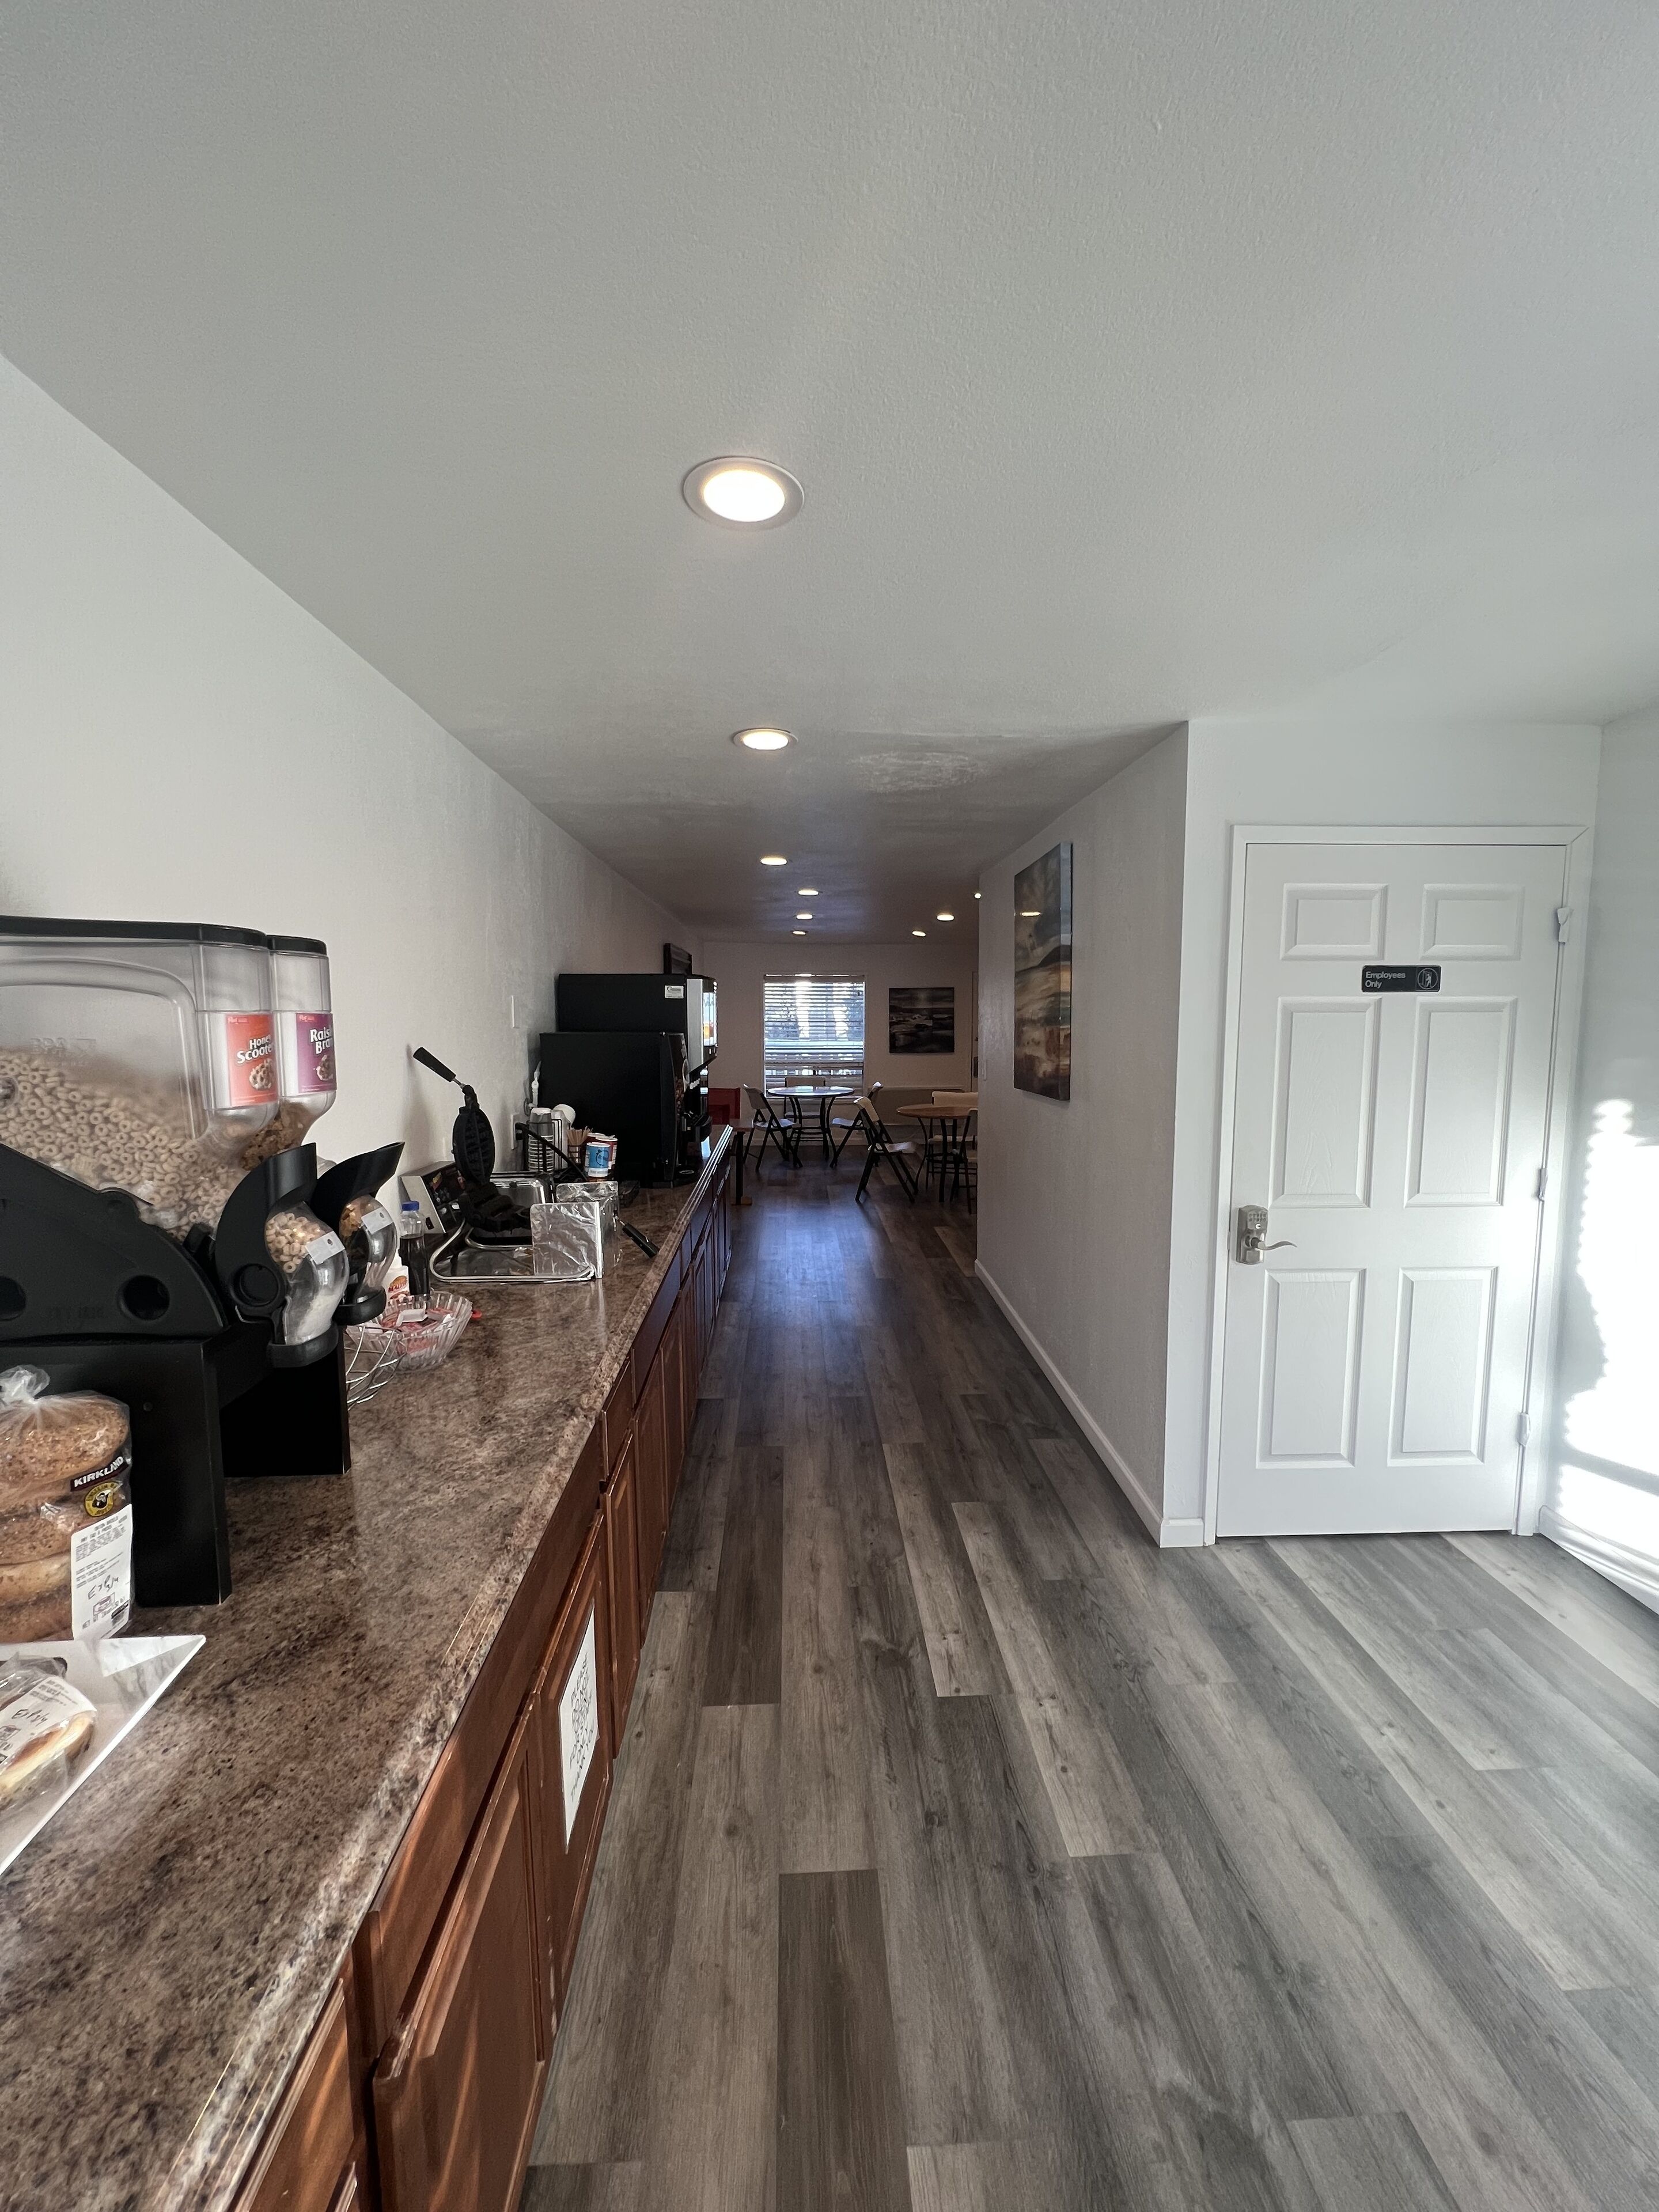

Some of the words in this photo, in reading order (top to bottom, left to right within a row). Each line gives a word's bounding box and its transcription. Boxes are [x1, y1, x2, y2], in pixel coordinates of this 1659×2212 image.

[1365, 971, 1406, 980] Employees
[1365, 980, 1382, 989] Only
[310, 1027, 332, 1043] Rais
[237, 1043, 274, 1064] Scoote
[74, 1456, 124, 1487] KIRKLAND
